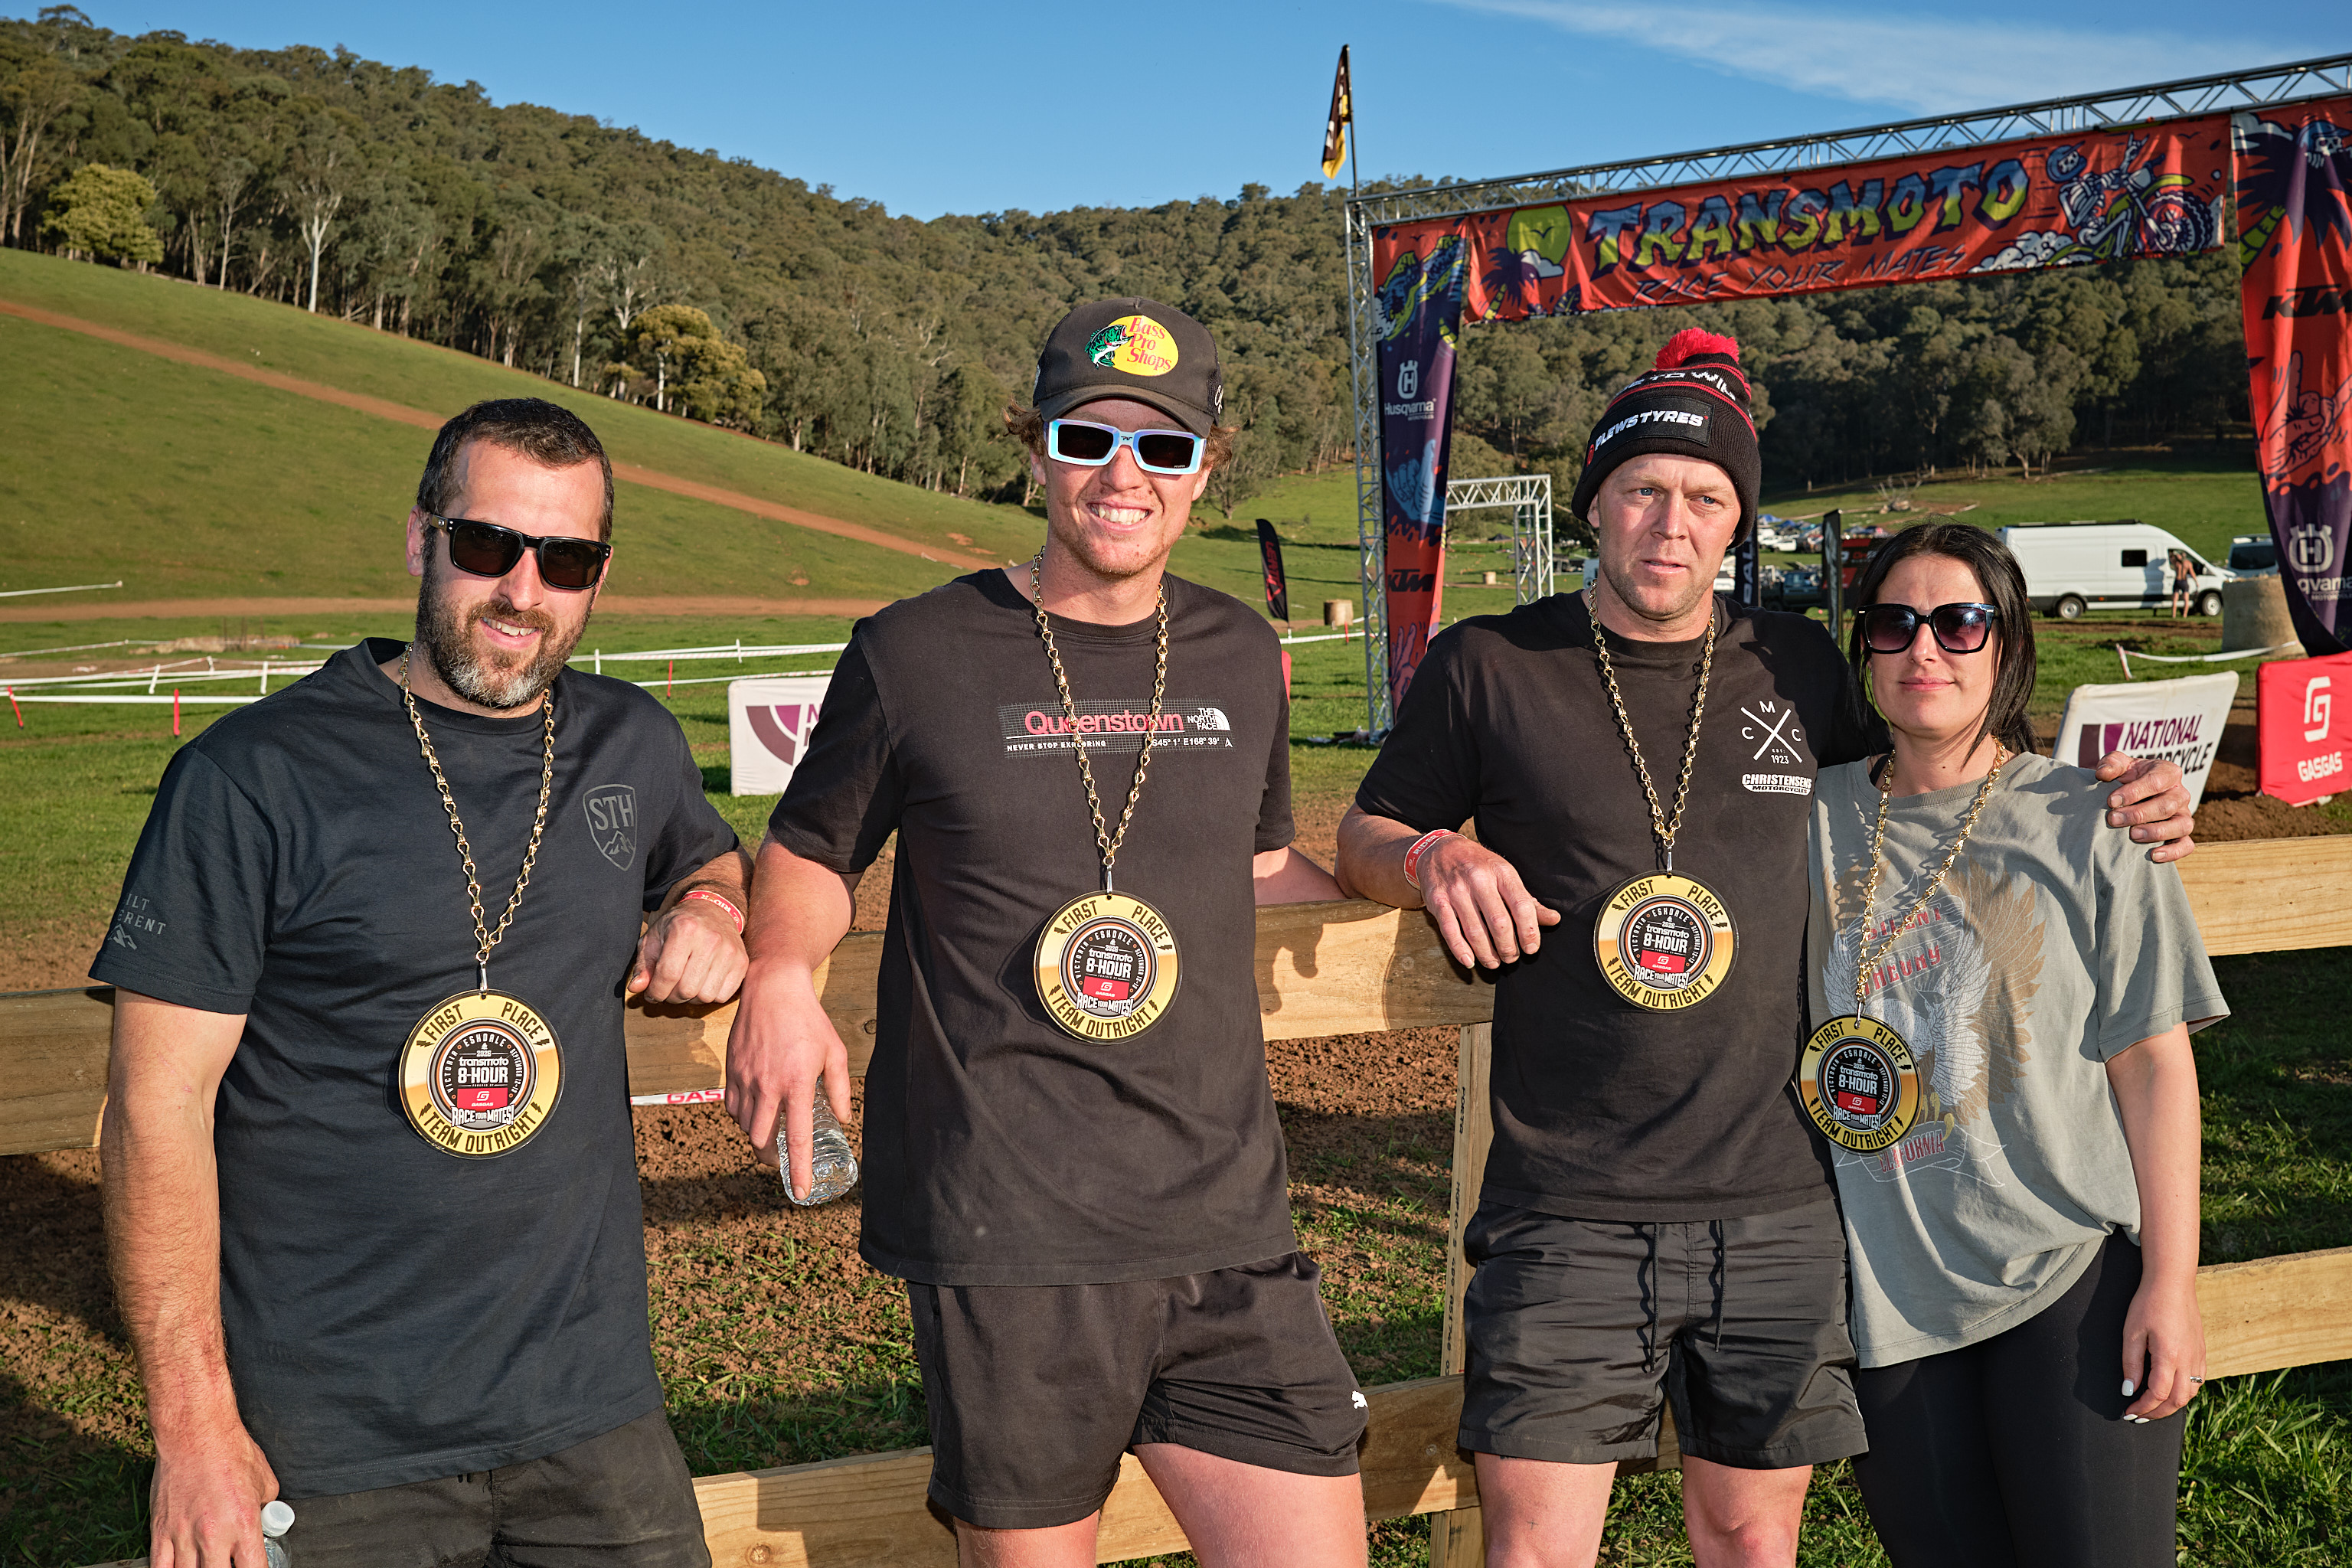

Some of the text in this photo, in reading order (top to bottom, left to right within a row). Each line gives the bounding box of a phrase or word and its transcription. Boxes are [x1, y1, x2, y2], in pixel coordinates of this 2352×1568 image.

[1583, 159, 2028, 280] TRANSMOTO
[1631, 244, 1966, 303] RACE YOUR MATES
[1129, 317, 1165, 339] Bass
[1129, 333, 1156, 351] Pro
[1127, 348, 1171, 371] Shops
[1383, 400, 1435, 416] Husqvarna
[1595, 410, 1704, 451] PLEWS TYRES
[1388, 569, 1435, 593] KTM
[1197, 707, 1214, 716] THE
[1759, 701, 1775, 713] M
[1187, 715, 1216, 724] NORTH
[1741, 727, 1802, 742] C C
[2124, 714, 2203, 750] NATIONAL
[1007, 743, 1034, 752] NEVER
[1771, 754, 1789, 764] 1923
[2298, 751, 2343, 782] GASGAS
[1742, 773, 1812, 789] CHRISTENSENS
[589, 794, 634, 831] STH
[1620, 880, 1723, 920] FIRST PLACE
[1062, 900, 1168, 942] FIRST PLACE
[1652, 907, 1689, 922] ESHDALE
[1095, 930, 1133, 945] ESHDALE
[1632, 918, 1646, 952] VICTORIA
[1646, 924, 1689, 939] transmoto
[1643, 933, 1687, 953] 8-HOUR
[1074, 942, 1089, 978] VICTORIA
[1089, 948, 1133, 962] transmoto
[1086, 958, 1132, 978] 8-HOUR
[1634, 964, 1655, 981] RACE
[1664, 972, 1690, 989] MATES!
[1610, 965, 1707, 1008] TEAM OUTRIGHT
[1052, 993, 1152, 1037] TEAM OUTRIGHT
[1076, 991, 1098, 1009] RACE
[1108, 999, 1134, 1018] MATES!
[424, 1002, 543, 1040] FIRST PLACE
[463, 1034, 506, 1047] ESHDALE
[1815, 1021, 1906, 1063] FIRST PLACE
[459, 1057, 509, 1066] transmoto
[1844, 1050, 1877, 1063] ESHDALE
[445, 1050, 458, 1093] VICTORIA
[458, 1067, 508, 1083] 8-HOUR
[1829, 1060, 1839, 1093] VICTORIA
[1840, 1066, 1878, 1080] transmoto
[1839, 1074, 1877, 1095] 8-HOUR
[452, 1106, 475, 1126] RACE
[487, 1104, 514, 1125] MATES!
[1834, 1105, 1851, 1120] RACE
[1860, 1114, 1881, 1131] MATES!
[424, 1112, 537, 1152] TEAM OUTRIGHT
[1813, 1105, 1898, 1148] TEAM OUTRIGHT
